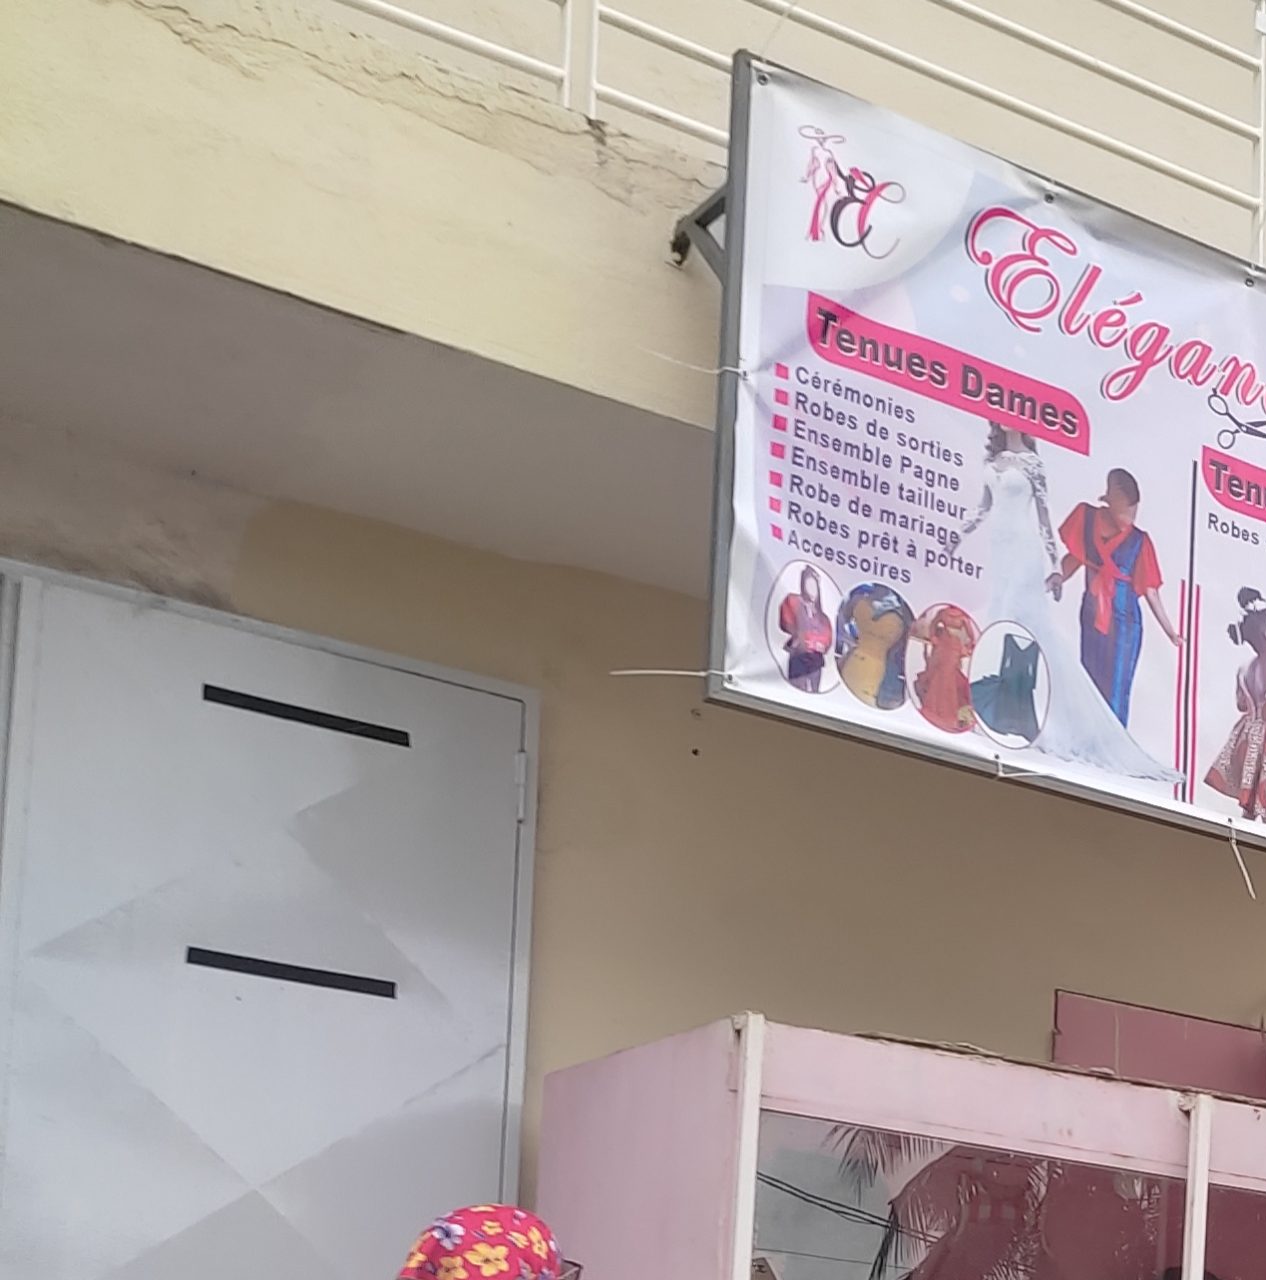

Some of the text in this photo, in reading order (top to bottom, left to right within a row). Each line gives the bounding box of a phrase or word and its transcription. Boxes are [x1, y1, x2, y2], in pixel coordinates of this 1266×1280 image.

[795, 365, 916, 424] Cérémonies
[816, 306, 1079, 436] Tenues Dames
[793, 417, 960, 492] Ensemble Pagne
[795, 390, 964, 468] Robes de sorties
[790, 474, 960, 547] Robe de mariage
[791, 446, 966, 520] Ensemble tailleur
[787, 500, 983, 580] Robes prêt à porter
[787, 530, 912, 583] Accessoires
[1208, 512, 1260, 545] Robes
